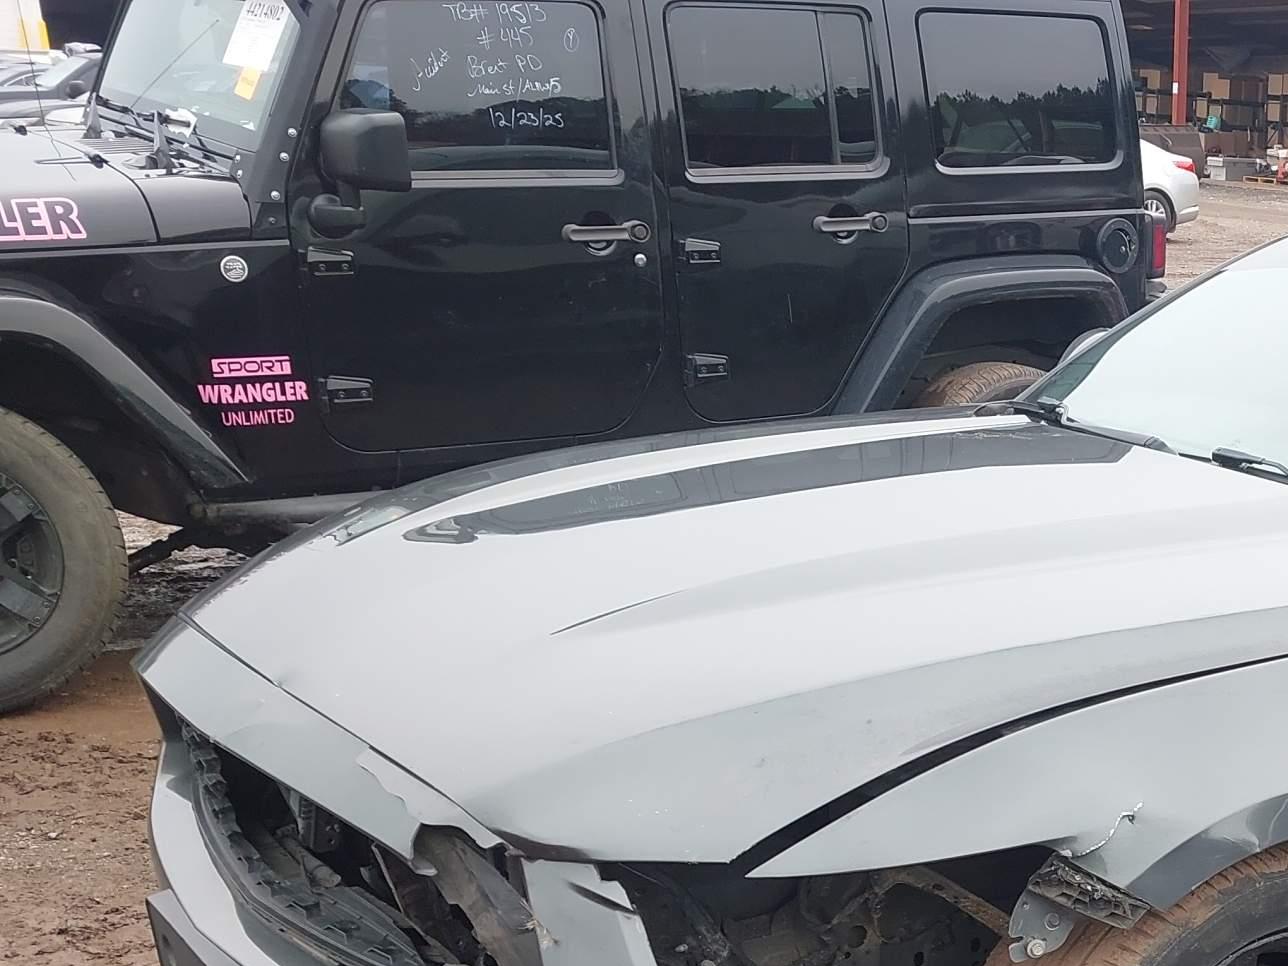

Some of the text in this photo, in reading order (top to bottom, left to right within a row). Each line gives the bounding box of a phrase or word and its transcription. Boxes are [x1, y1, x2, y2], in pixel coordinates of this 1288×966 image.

[488, 107, 565, 129] 12/23/25
[212, 359, 291, 375] SPORT
[197, 381, 309, 404] WRANGLER
[221, 408, 295, 426] UNLIMITED
